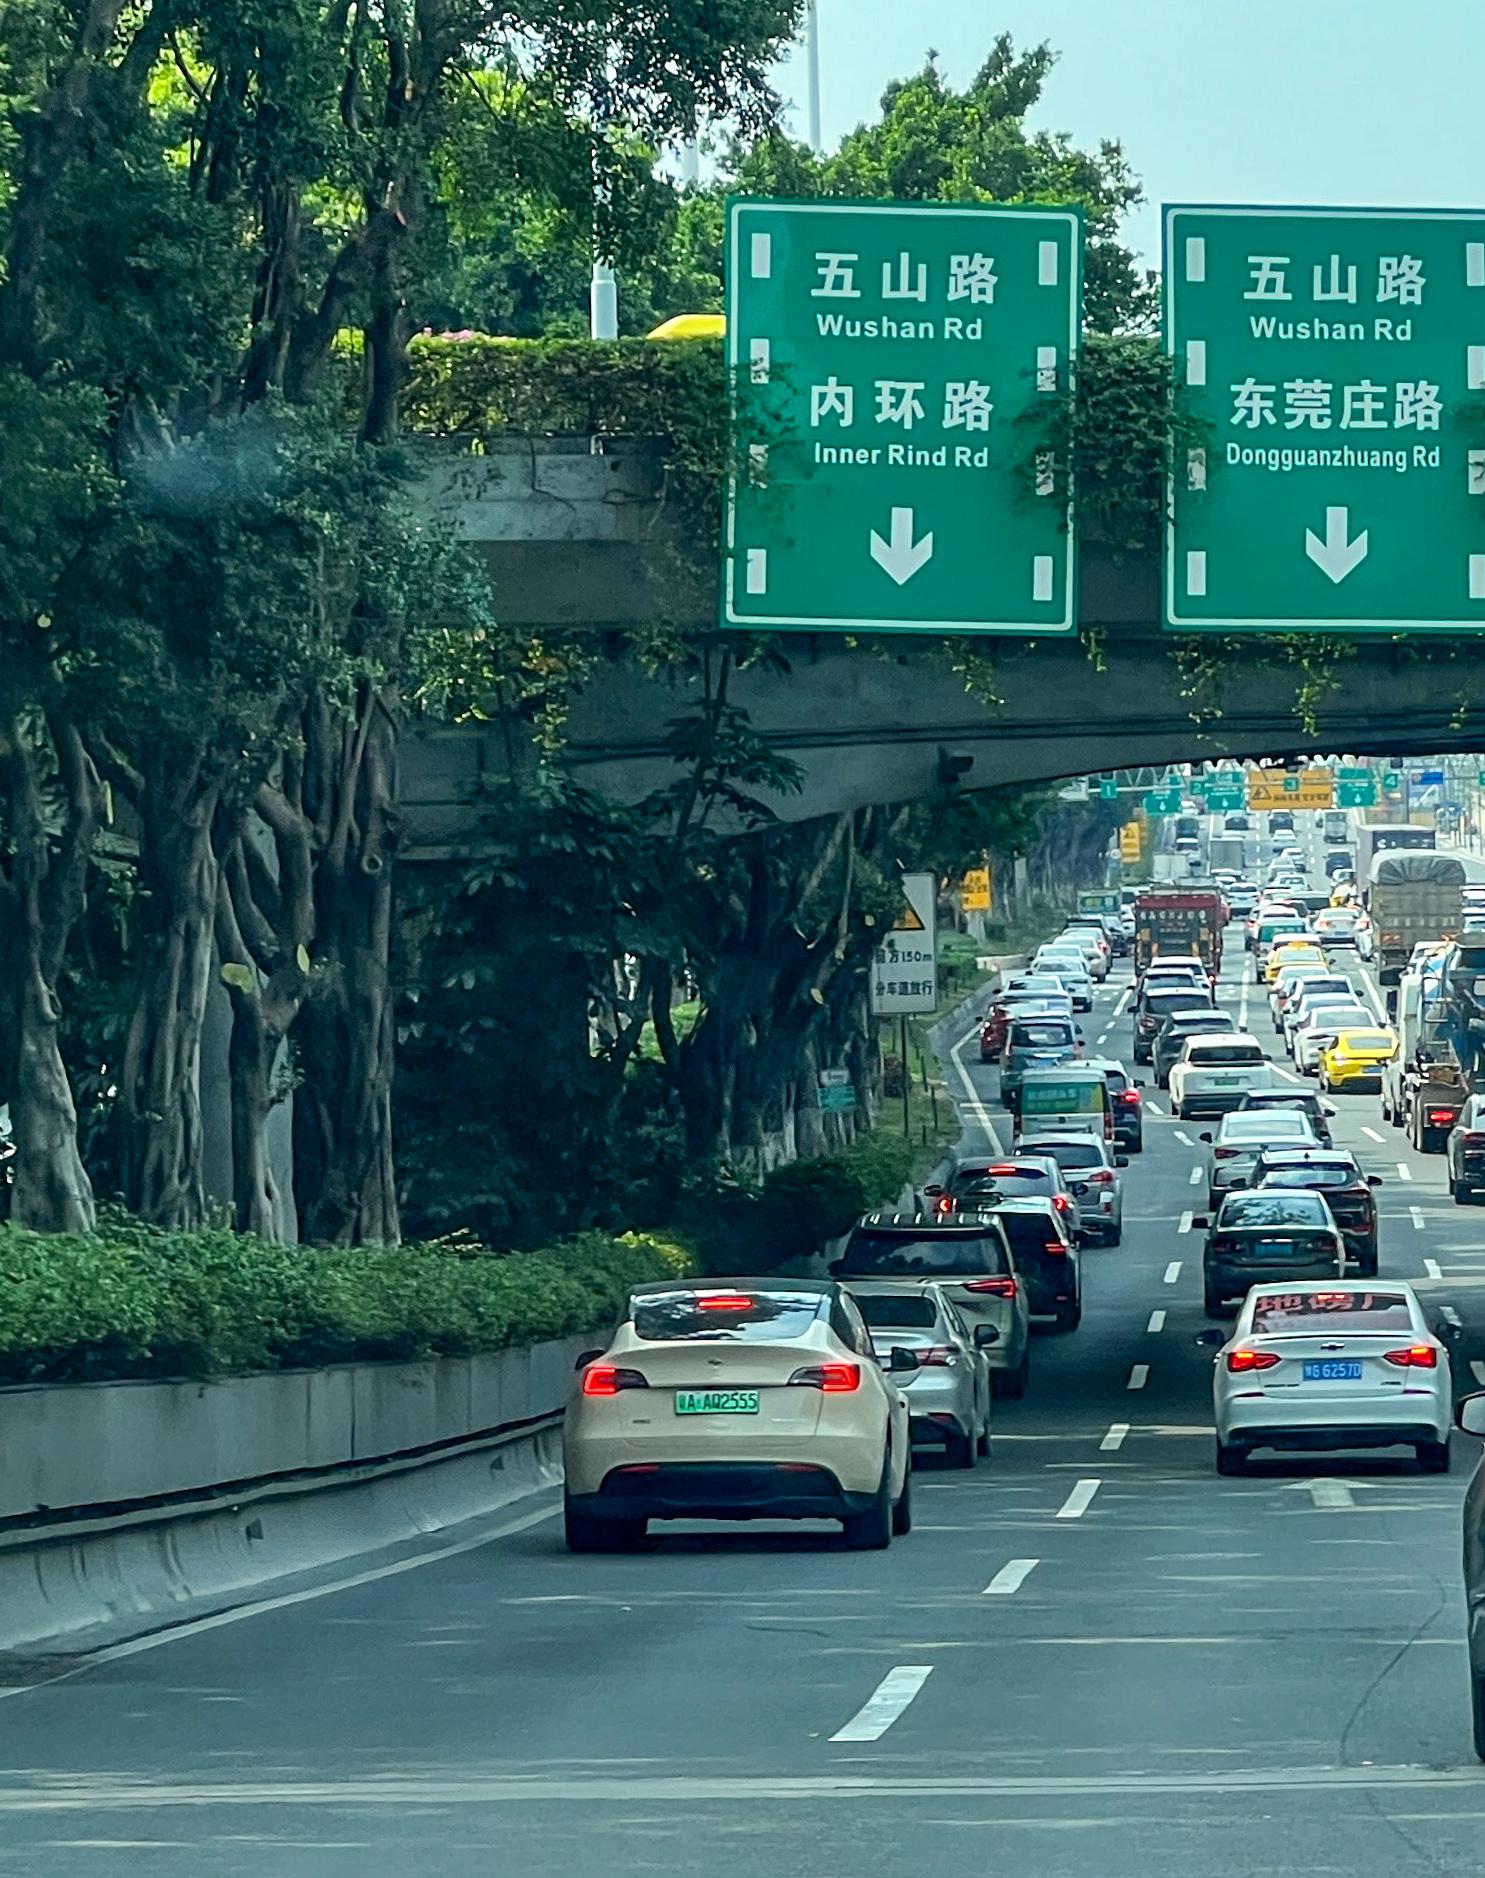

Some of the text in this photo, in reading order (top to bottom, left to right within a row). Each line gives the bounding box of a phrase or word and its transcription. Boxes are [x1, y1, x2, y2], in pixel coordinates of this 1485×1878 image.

[810, 251, 998, 305] 五山路
[1243, 254, 1426, 306] 五山路
[816, 313, 983, 342] Wushan Rd
[1250, 316, 1412, 342] Wushan Rd
[810, 375, 994, 433] 内环路
[1230, 377, 1444, 432] 东莞庄路
[814, 442, 989, 469] Inner Rind Rd
[1226, 442, 1441, 474] Dongguanzhuang Rd
